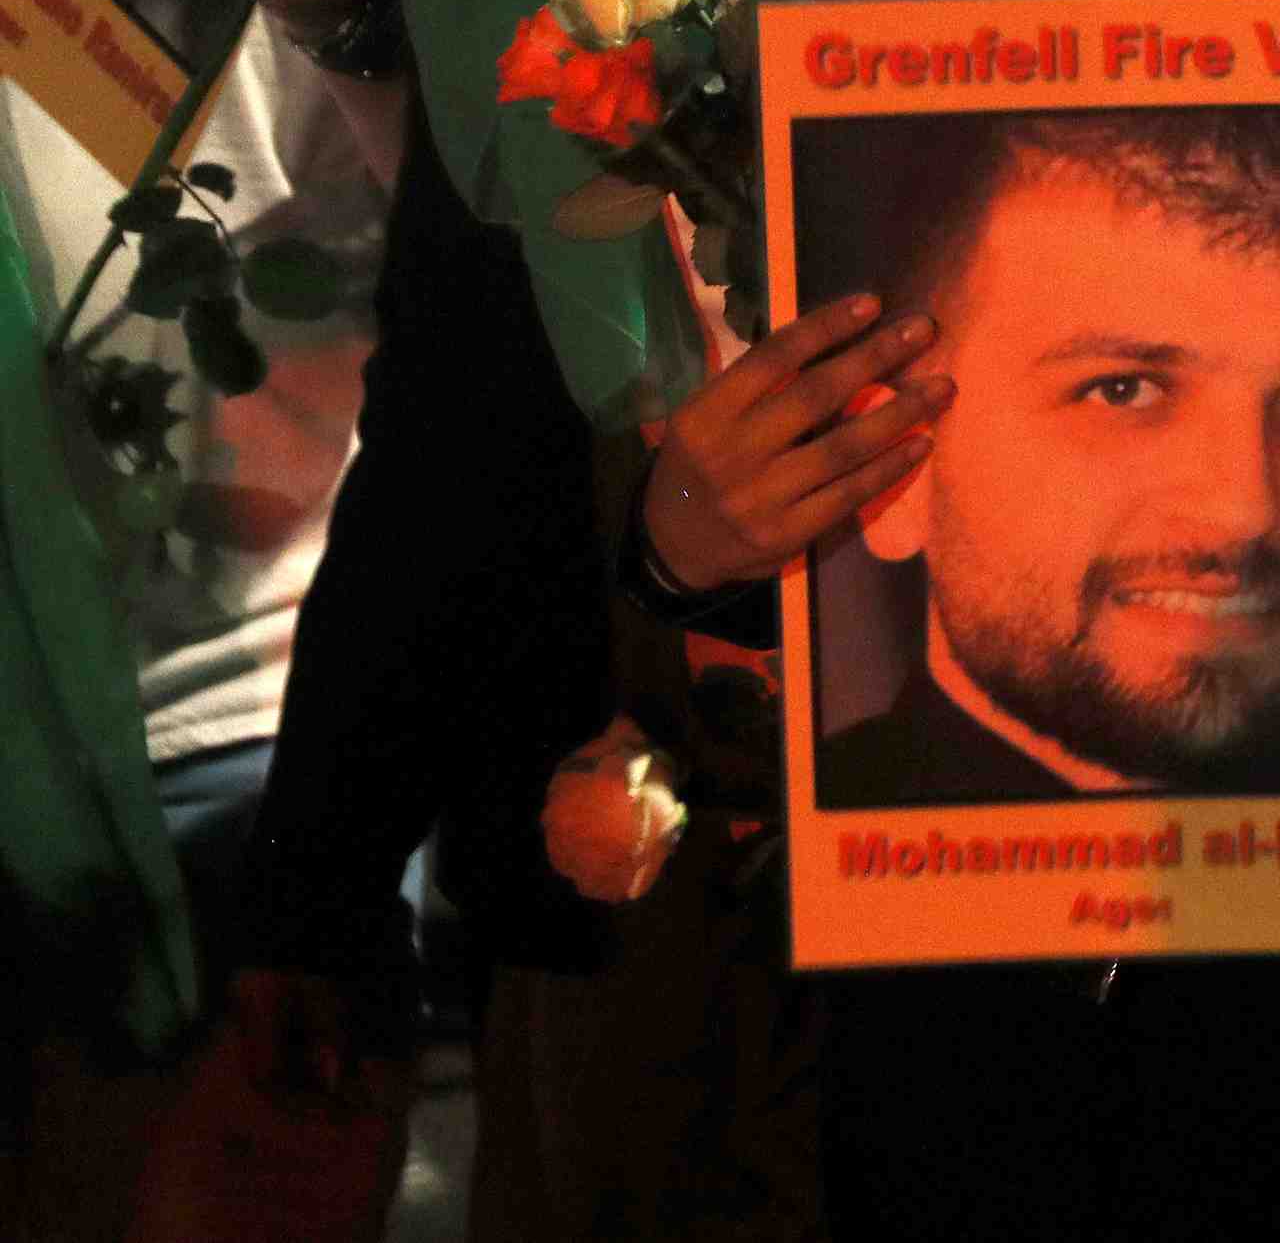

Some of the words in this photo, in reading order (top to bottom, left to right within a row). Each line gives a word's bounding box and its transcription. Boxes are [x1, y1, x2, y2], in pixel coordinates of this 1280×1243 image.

[804, 25, 1079, 89] Grenfell
[1102, 23, 1235, 80] Fire
[837, 821, 1182, 879] Mohammad
[1069, 892, 1172, 933] Age:
